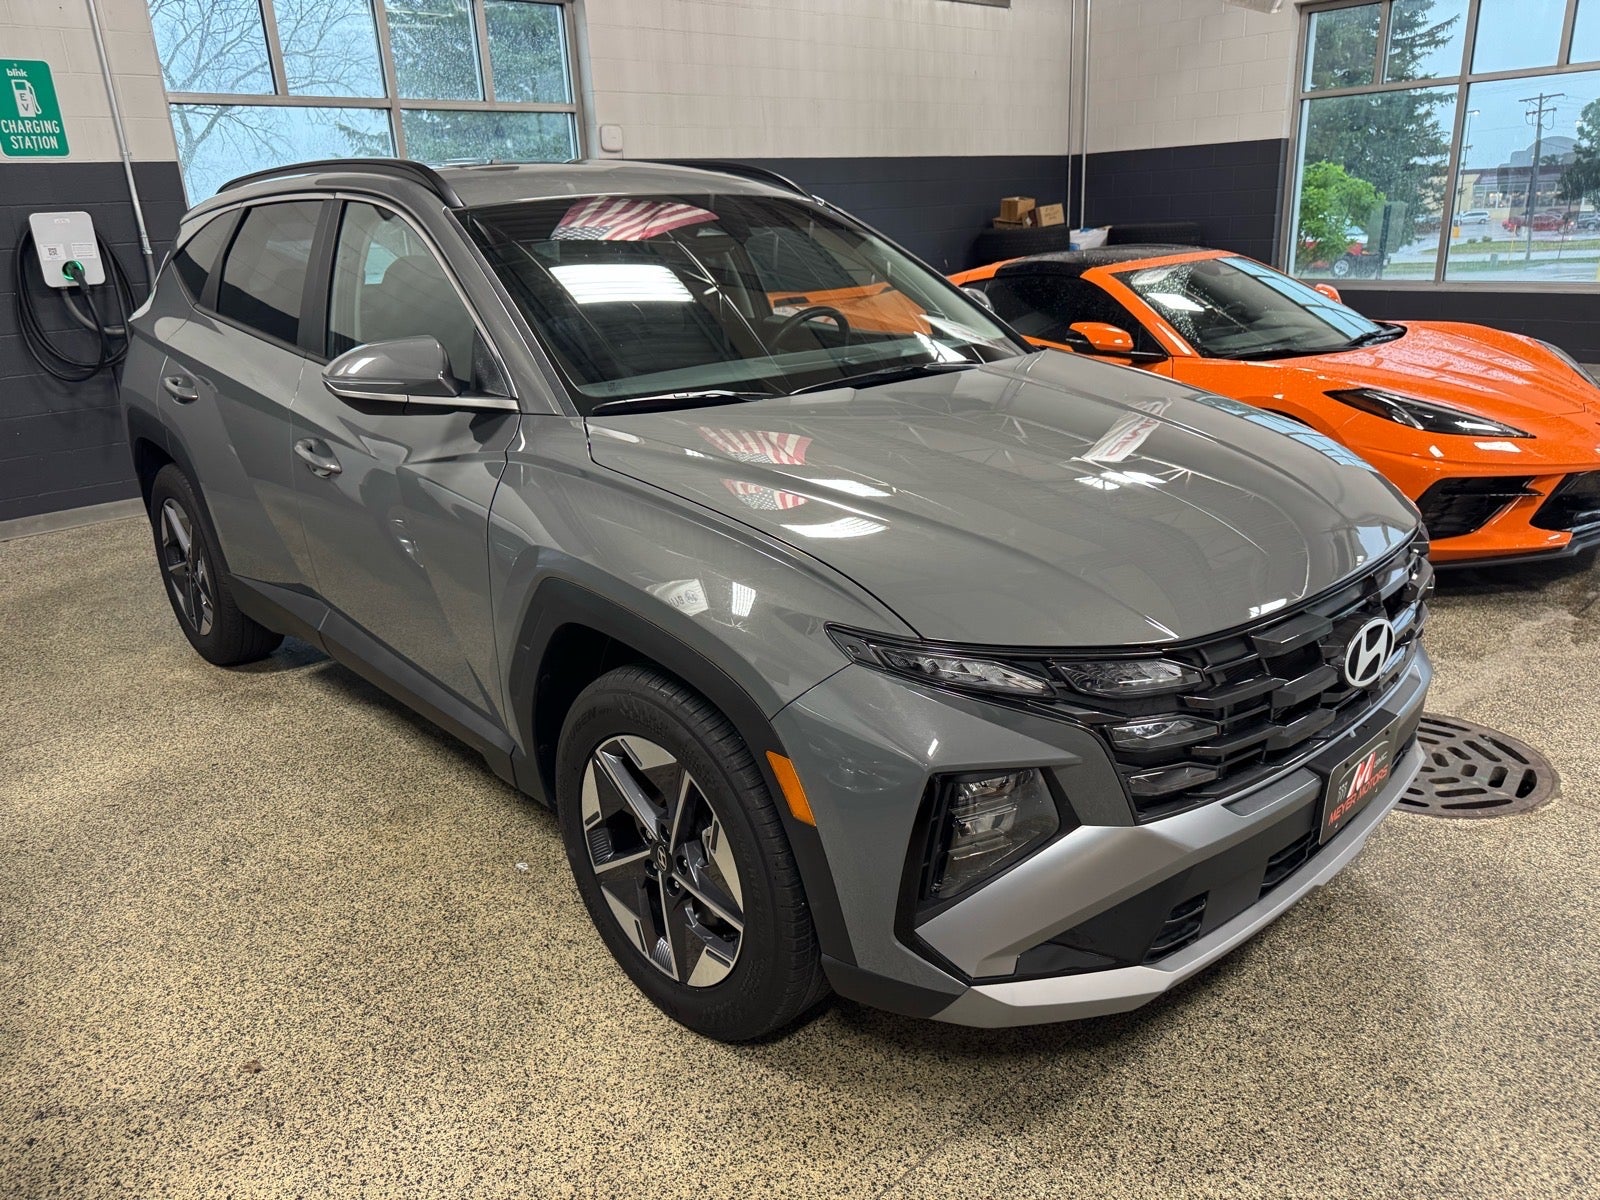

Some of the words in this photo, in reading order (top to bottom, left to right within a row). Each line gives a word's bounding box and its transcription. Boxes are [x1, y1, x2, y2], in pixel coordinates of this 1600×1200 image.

[6, 64, 28, 77] blink
[1, 119, 60, 134] CHARGING
[10, 135, 59, 151] STATION
[1328, 793, 1357, 826] MEYER
[1356, 764, 1389, 801] MOTORS
